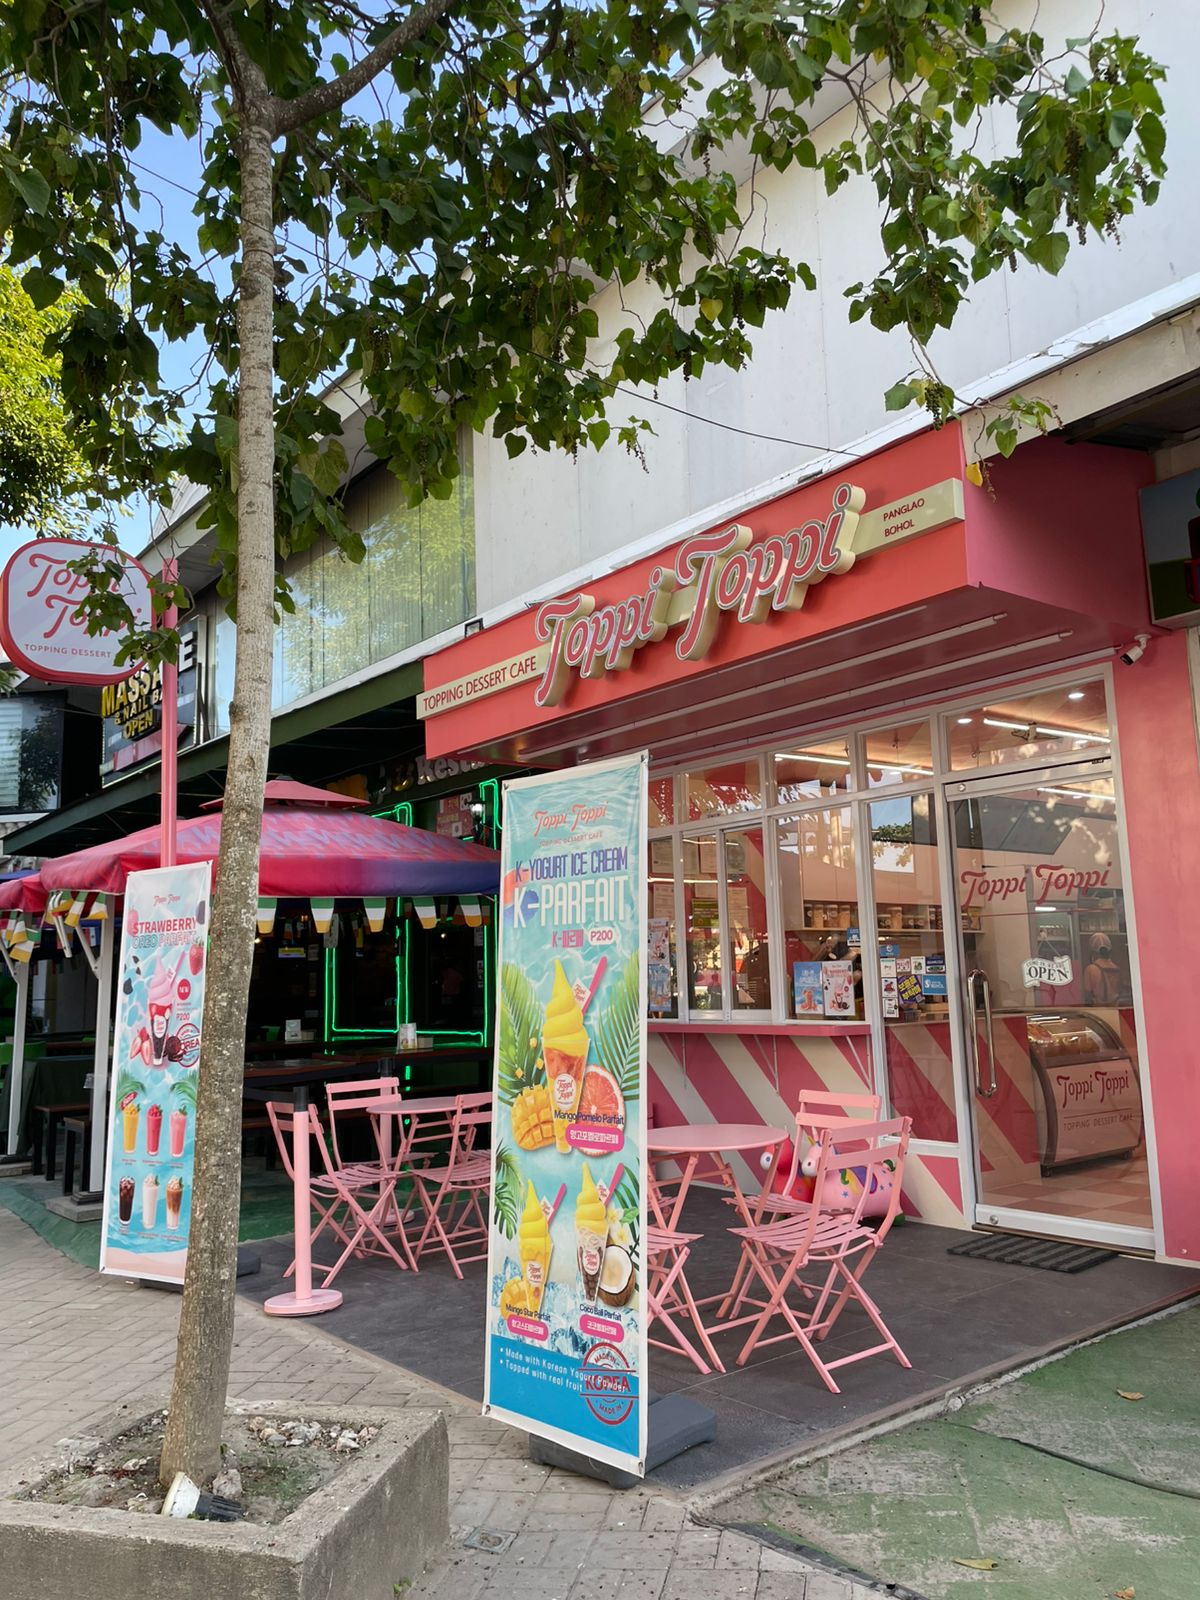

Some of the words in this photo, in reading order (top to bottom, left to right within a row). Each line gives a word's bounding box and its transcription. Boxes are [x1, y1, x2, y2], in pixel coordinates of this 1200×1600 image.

[883, 498, 925, 521] PANGLAO
[884, 519, 915, 537] BOHOL
[534, 566, 670, 707] Toppi
[675, 483, 856, 661] Toppi
[25, 643, 68, 655] TOPPING
[71, 648, 112, 658] DESSERT
[423, 684, 464, 711] TOPPING
[465, 667, 507, 696] DESSERT
[509, 656, 536, 679] CAFE
[123, 696, 149, 720] NAIL
[123, 709, 153, 739] OPEN
[533, 807, 569, 838] Toppi
[571, 800, 609, 832] Toppi
[515, 854, 568, 882] K-YOGURT
[571, 852, 587, 876] ICE
[591, 846, 628, 873] CREAM
[960, 869, 1030, 909] Toppi
[1035, 862, 1112, 906] Toppi
[513, 876, 629, 929] K-PARFAIT
[132, 917, 197, 935] STRAWBERRY
[590, 929, 613, 942] P200
[132, 934, 158, 949] OREO
[1028, 965, 1069, 981] OPEN
[1056, 1074, 1094, 1108] Toppi
[1094, 1070, 1129, 1103] Toppi
[603, 1114, 624, 1124] Parfait
[1063, 1119, 1091, 1131] TOPPING
[1093, 1115, 1118, 1127] DESSERT
[579, 1303, 593, 1314] Coco
[604, 1309, 622, 1321] Parfait
[505, 1347, 523, 1361] Made
[525, 1355, 541, 1366] with
[542, 1359, 567, 1374] Korean
[597, 1376, 625, 1392] Powder
[505, 1360, 530, 1375] Topped
[532, 1369, 547, 1380] with
[549, 1375, 563, 1386] real
[566, 1379, 583, 1392] fruit
[585, 1374, 631, 1392] KOREA
